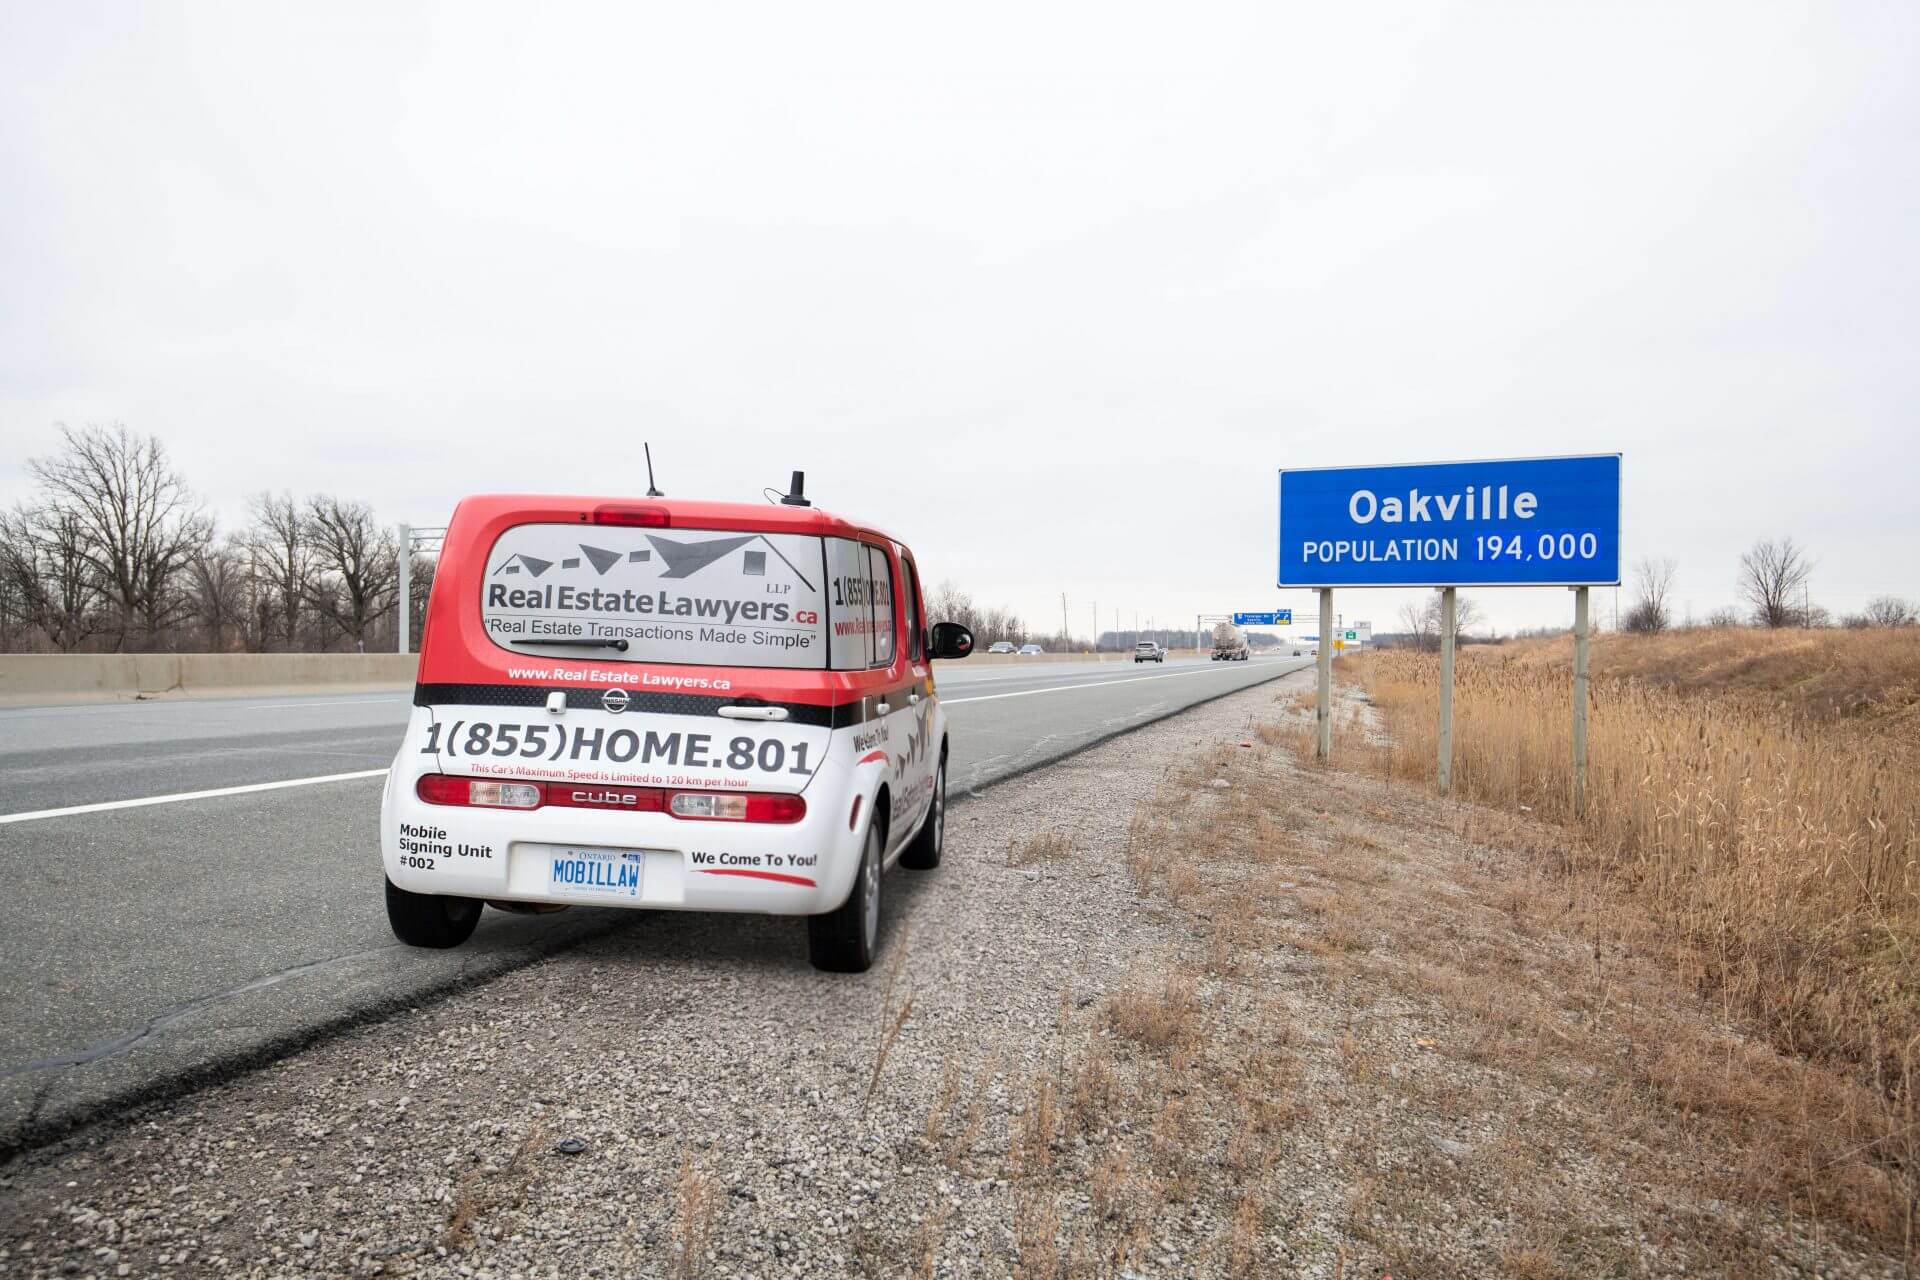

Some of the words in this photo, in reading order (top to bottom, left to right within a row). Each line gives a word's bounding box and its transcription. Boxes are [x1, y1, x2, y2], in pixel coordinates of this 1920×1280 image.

[1349, 485, 1538, 524] Oakville
[1303, 538, 1458, 563] POPULATION
[1476, 533, 1598, 562] 194,000
[766, 583, 791, 595] LLP
[531, 620, 582, 636] Estate
[589, 622, 693, 642] Transactions
[700, 627, 747, 645] Made
[508, 668, 586, 682] www.Real
[590, 670, 639, 685] Estate
[643, 673, 731, 690] Lawyers.ca
[420, 720, 814, 776] 1(855)HOME.801
[471, 763, 489, 773] This
[492, 765, 514, 775] Car's
[516, 766, 565, 778] Maximum
[568, 769, 599, 781] Speed
[601, 771, 609, 780] is
[611, 772, 649, 783] Limited
[652, 775, 662, 784] to
[666, 775, 684, 785] 120
[686, 776, 702, 785] km
[704, 778, 721, 788] per
[724, 777, 749, 787] hour
[572, 791, 637, 806] cube
[399, 838, 453, 858] Signing
[458, 844, 493, 859] Unit
[692, 851, 716, 865] We
[719, 853, 761, 865] Come
[765, 854, 783, 866] To
[787, 854, 817, 866] You!
[400, 855, 435, 870] #002
[553, 859, 639, 887] MOBILLAW
